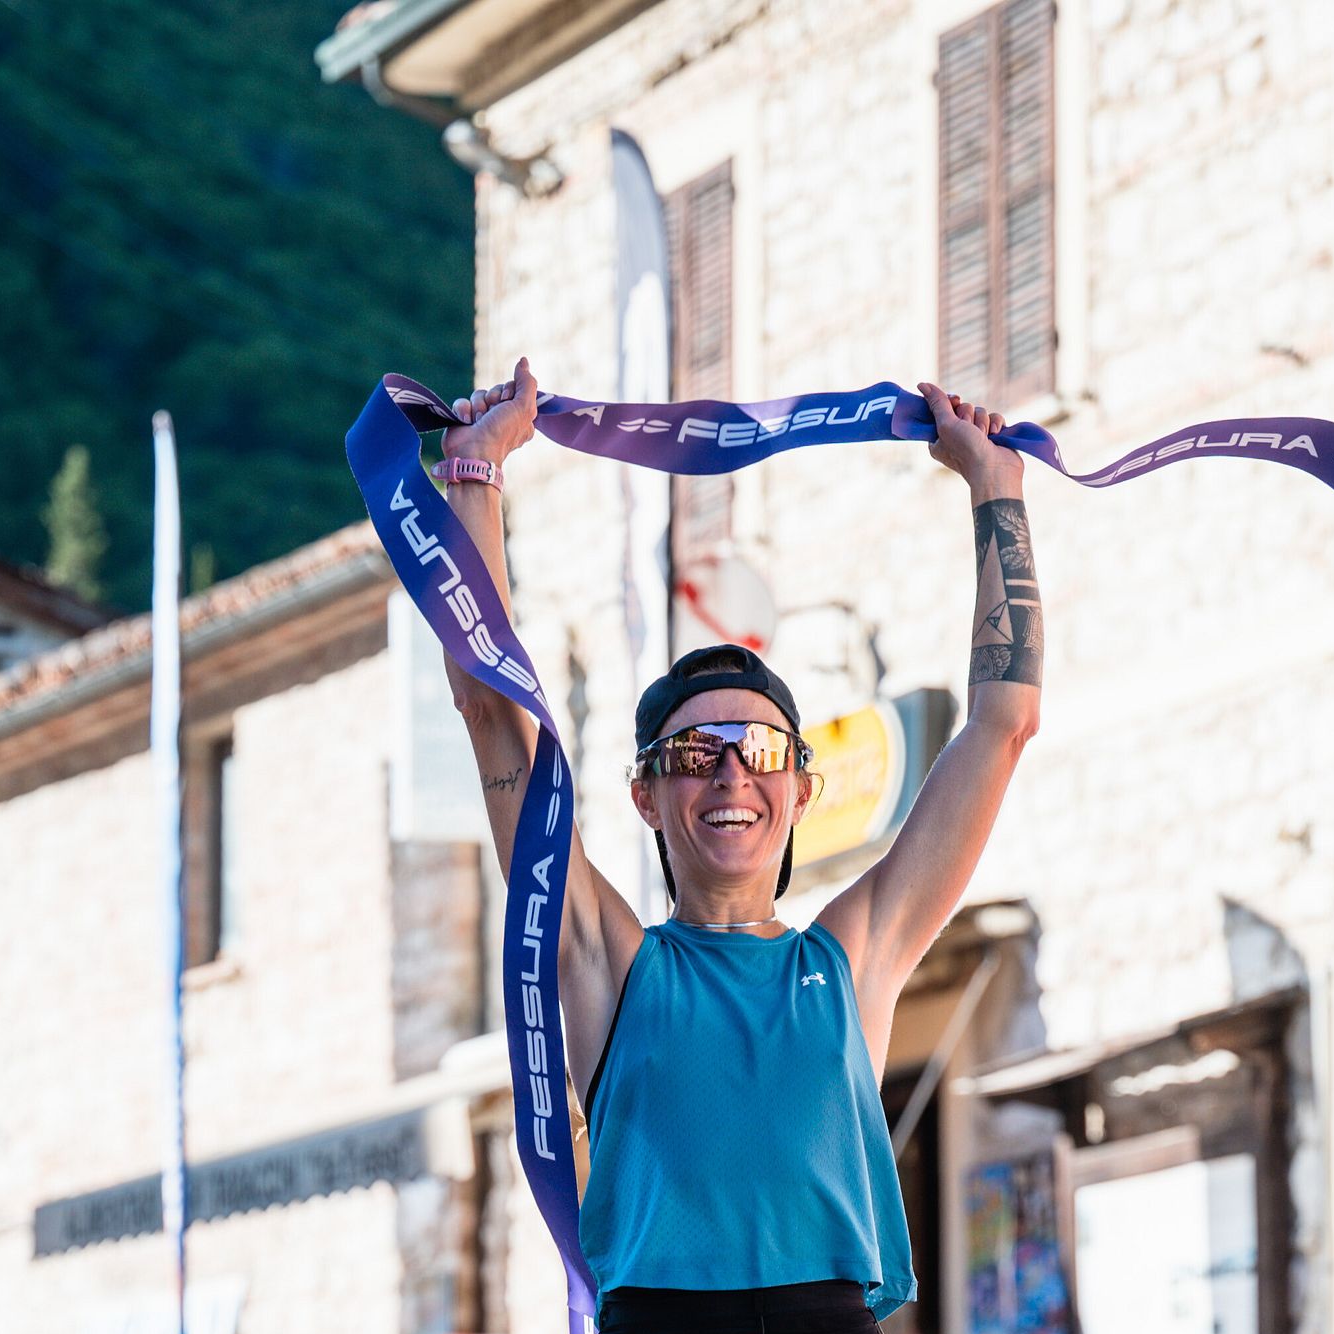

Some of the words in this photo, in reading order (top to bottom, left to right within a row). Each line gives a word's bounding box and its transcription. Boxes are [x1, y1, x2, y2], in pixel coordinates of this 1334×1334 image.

[677, 396, 899, 448] FESSUR
[1077, 432, 1319, 486] SSURA
[389, 478, 554, 722] ESSURA
[521, 853, 556, 1161] FESSURA
